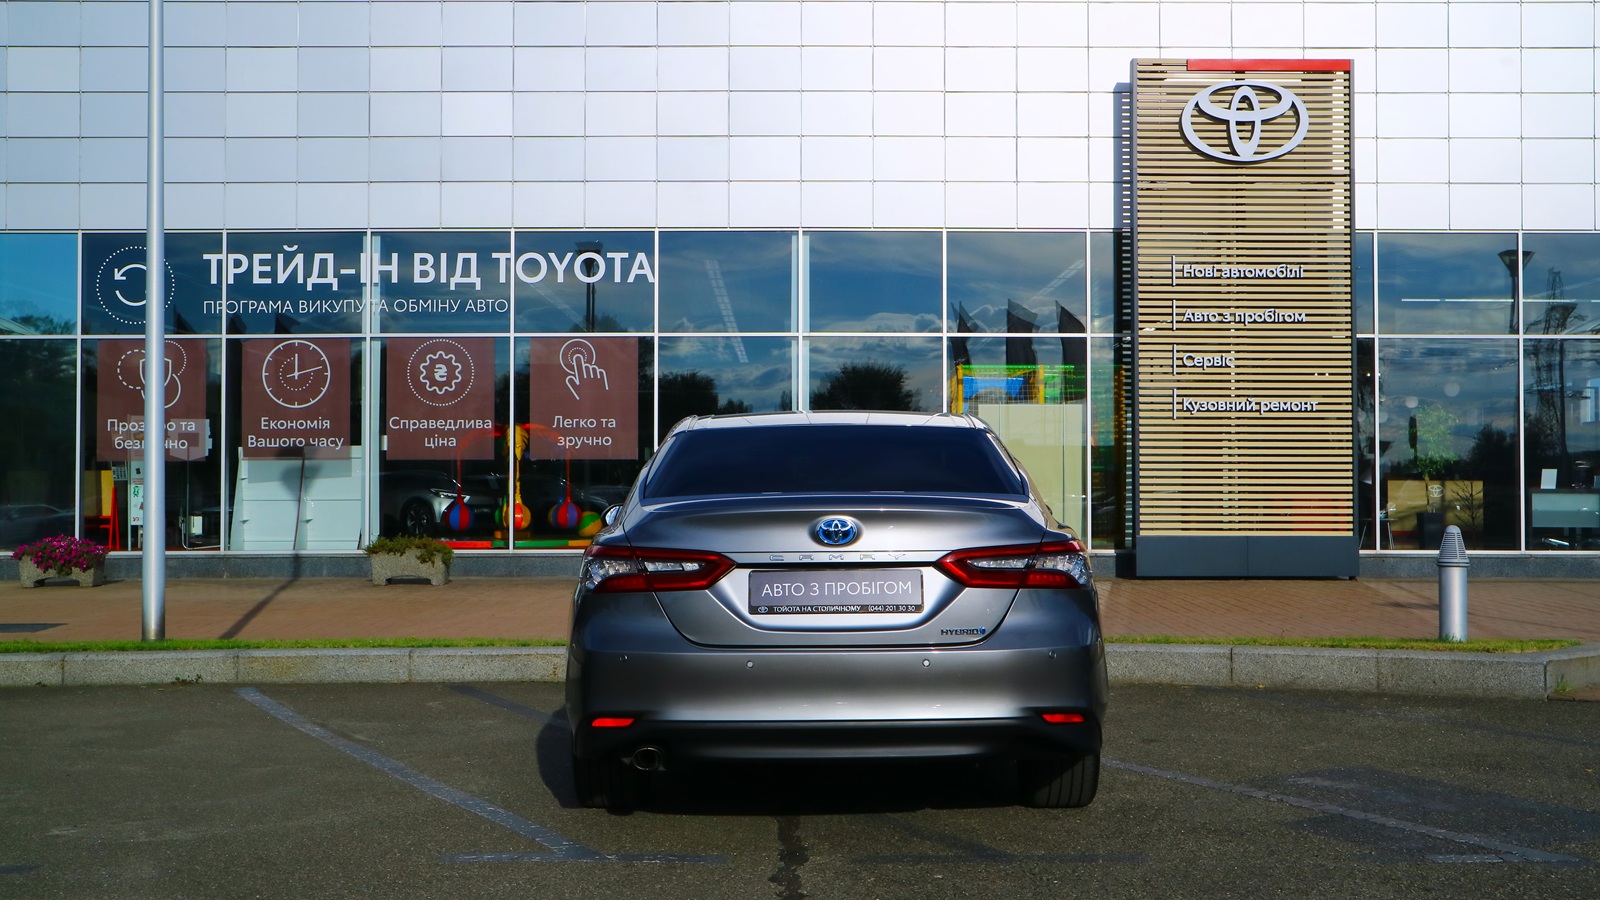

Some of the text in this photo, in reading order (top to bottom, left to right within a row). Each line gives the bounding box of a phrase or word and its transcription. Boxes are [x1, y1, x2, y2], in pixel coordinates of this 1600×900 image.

[203, 244, 655, 291] ТРЕЙД-ІН ВІД TOYOTA
[1182, 264, 1304, 279] Нові автомобілі
[203, 300, 294, 314] ПРОГРАМА
[299, 300, 366, 314] ВИКУПУ
[393, 299, 460, 313] ОБМІНУ
[464, 299, 508, 313] АВТО
[1182, 309, 1306, 325] Авто з пробігом
[1182, 353, 1235, 370] Сервіс
[1182, 397, 1318, 414] Кузовний ремонт
[107, 419, 195, 434] Прозо та
[260, 417, 330, 430] Економія
[389, 417, 492, 431] Справедлива
[552, 416, 616, 429] Легко та
[247, 435, 344, 450] Вашого часу
[424, 435, 457, 448] ціна
[556, 436, 612, 448] зручно
[761, 581, 912, 597] АВТО З ПРОБІГОМ
[941, 628, 979, 636] HYBRID
